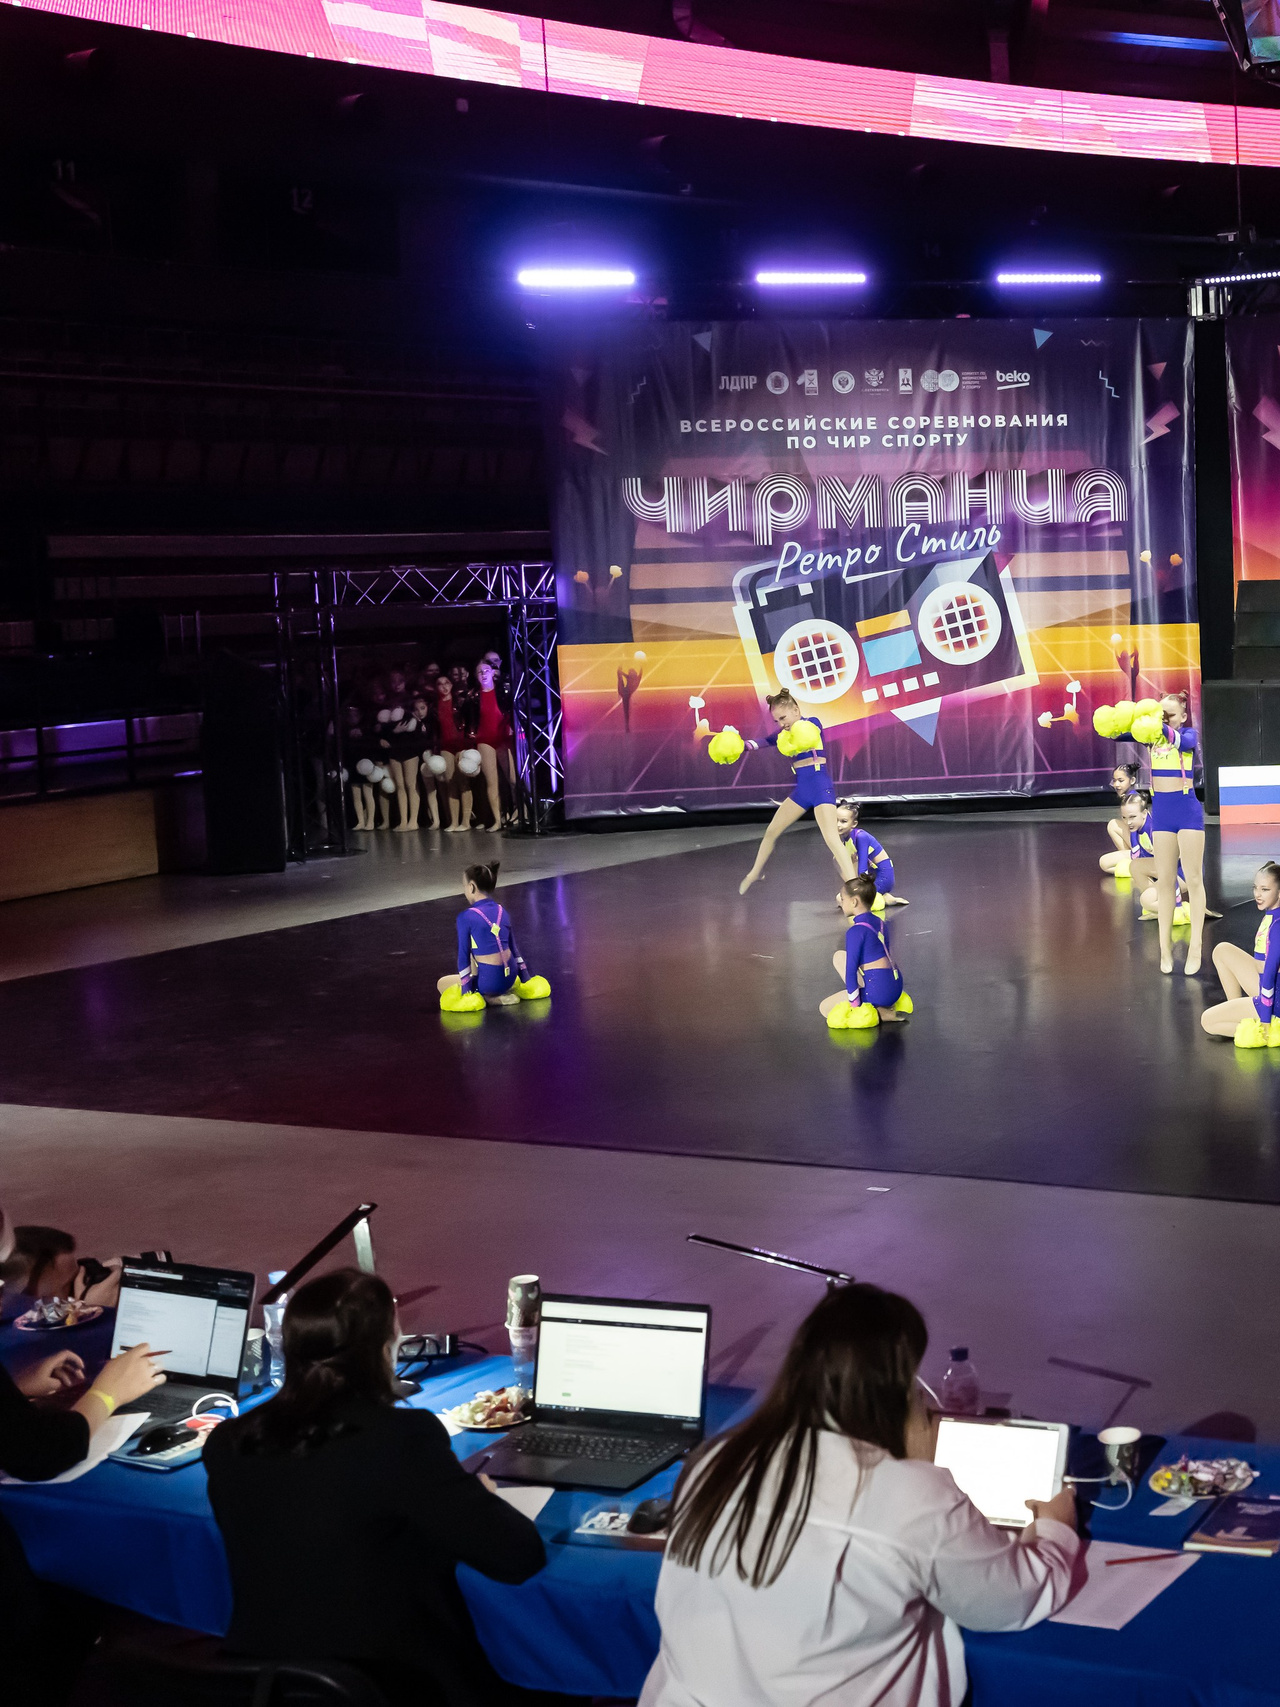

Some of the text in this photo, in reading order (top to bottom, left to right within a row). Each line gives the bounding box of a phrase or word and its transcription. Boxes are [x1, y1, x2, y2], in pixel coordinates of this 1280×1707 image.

[719, 375, 757, 391] ЛДПР
[996, 370, 1030, 382] beko
[680, 414, 1069, 433] ВСЕРОССИЙСКИЕ СОРЕВНОВАНИЯ
[786, 433, 969, 449] ПО ЧИР СПОРТУ
[775, 523, 1002, 583] Ретро Стиль
